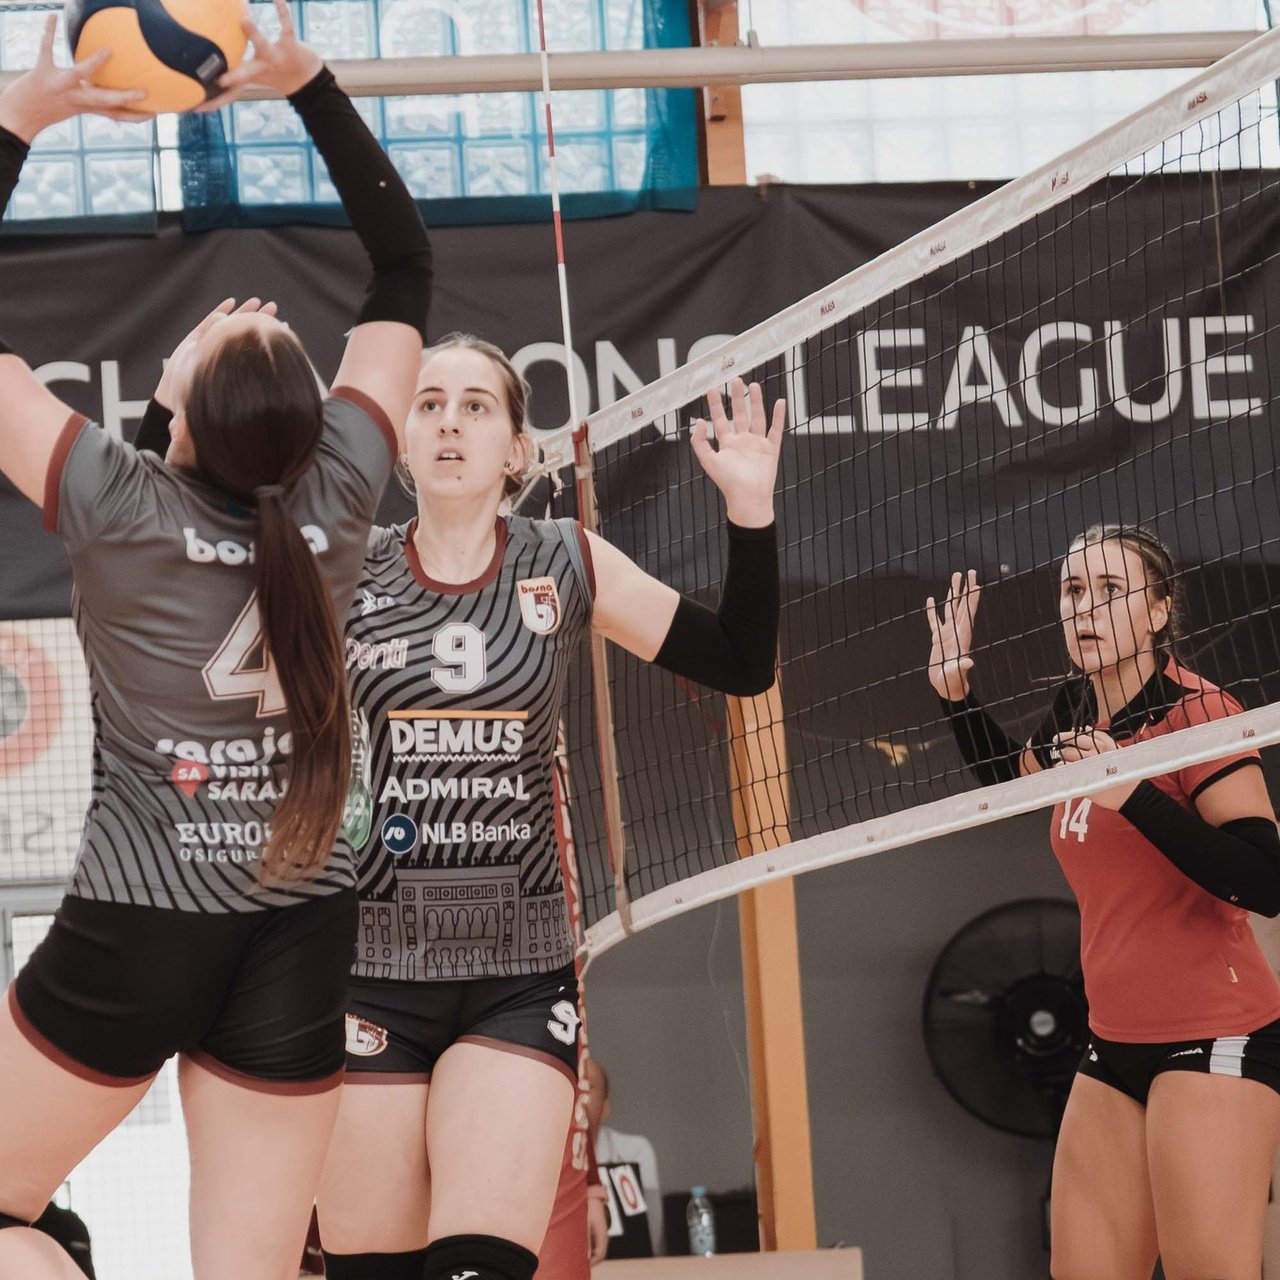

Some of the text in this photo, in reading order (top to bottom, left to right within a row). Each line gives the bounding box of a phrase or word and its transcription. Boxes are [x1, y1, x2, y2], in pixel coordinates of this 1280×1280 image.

[783, 314, 1264, 436] LEAGUE
[201, 586, 289, 719] 4
[431, 622, 487, 694] 9
[389, 719, 525, 754] DEMUS
[178, 766, 203, 781] SA
[378, 773, 531, 804] ADMIRAL
[422, 818, 532, 845] NLB Banka
